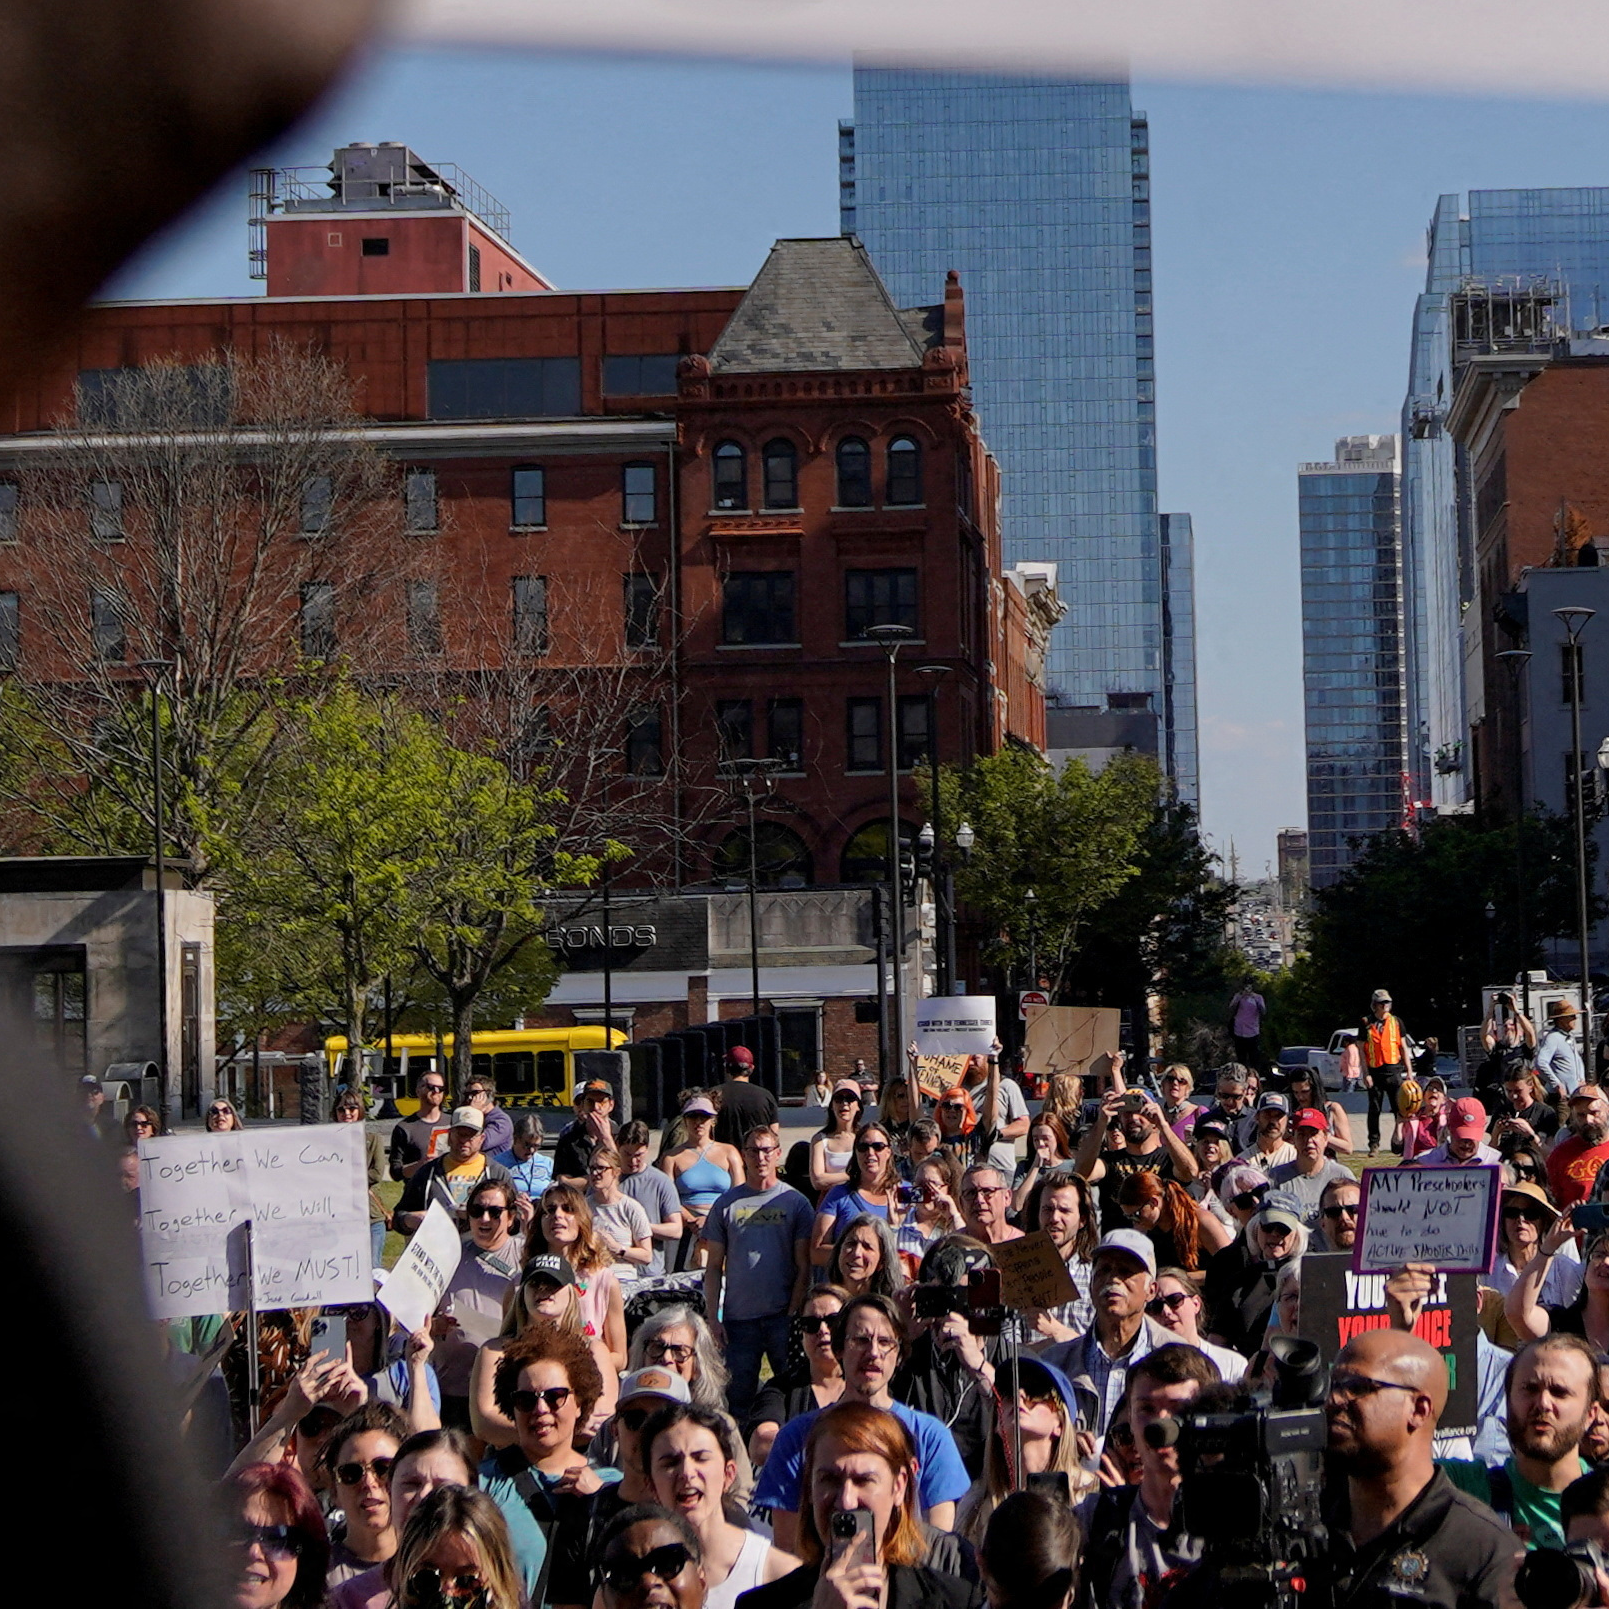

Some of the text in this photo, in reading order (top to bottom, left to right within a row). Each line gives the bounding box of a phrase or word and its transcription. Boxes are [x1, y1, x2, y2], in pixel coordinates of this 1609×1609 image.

[545, 924, 657, 948] BONDS
[141, 1144, 244, 1182] Together
[254, 1148, 284, 1169] We
[1369, 1171, 1402, 1194] MY
[144, 1205, 237, 1233] Together
[253, 1202, 287, 1223] We
[1423, 1194, 1475, 1219] NOT
[150, 1250, 360, 1298] Together We MUST!
[1411, 1309, 1452, 1348] OICE
